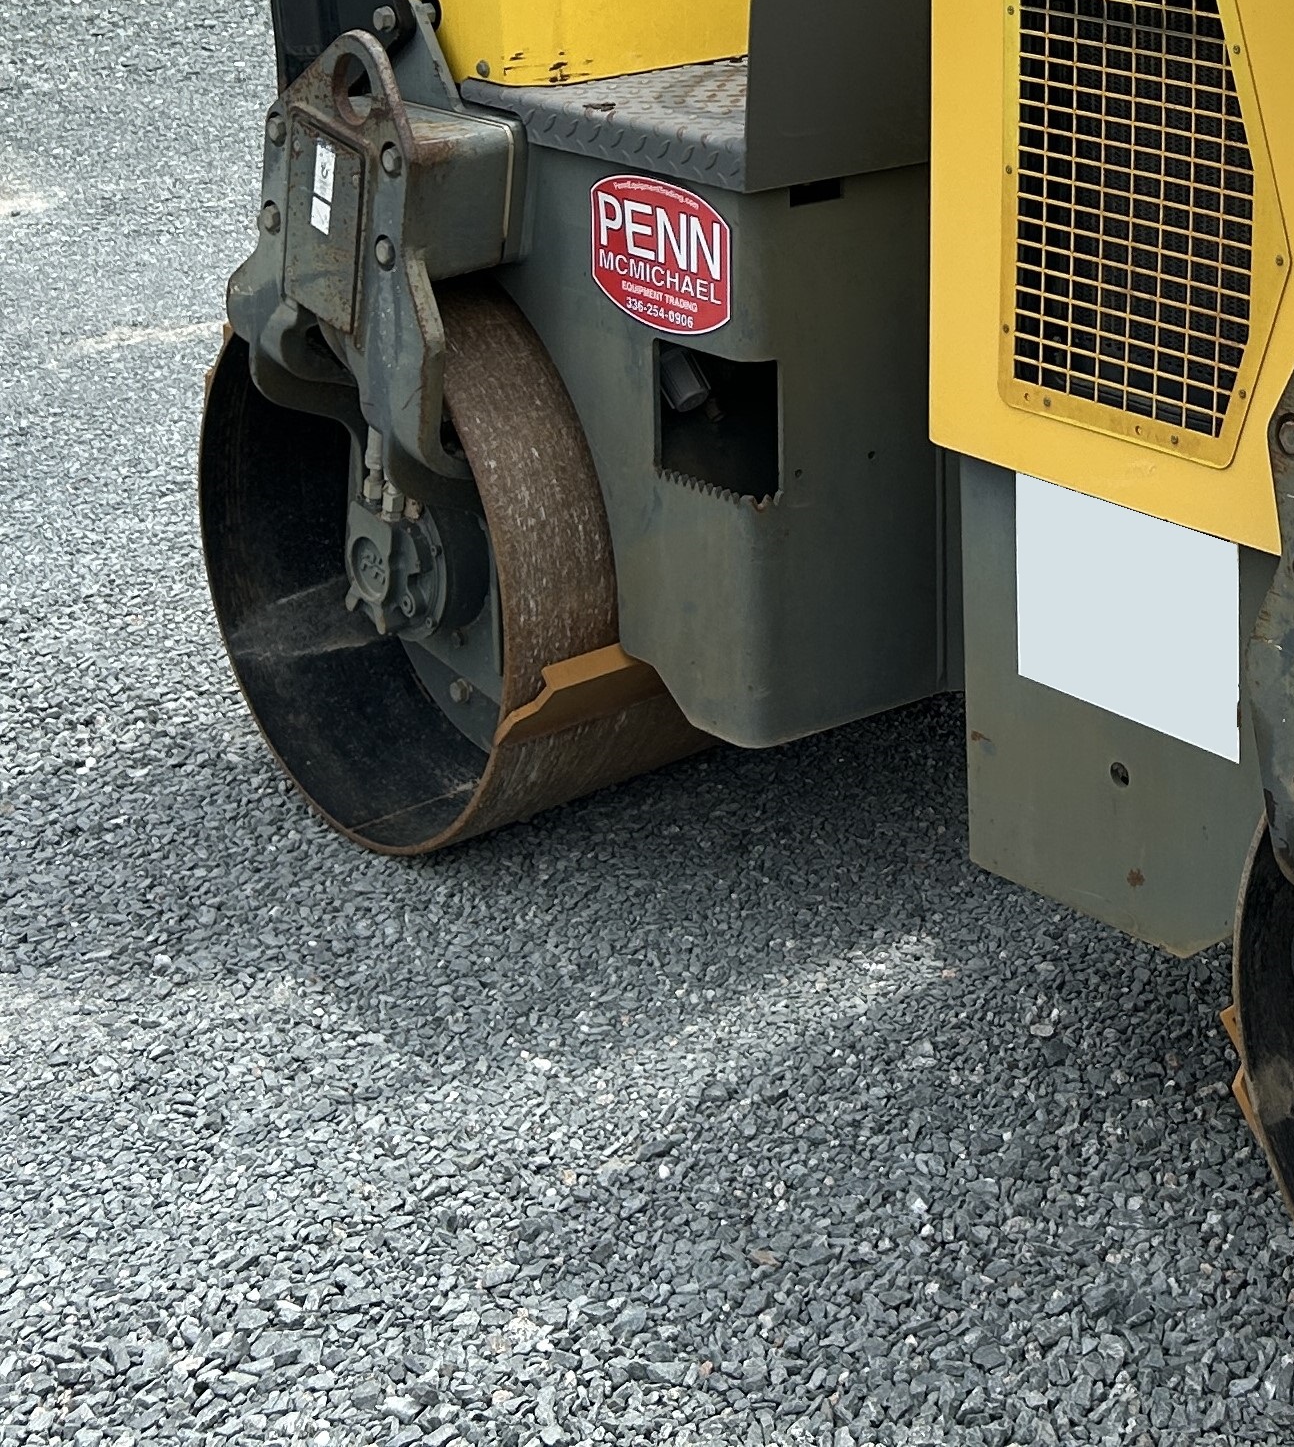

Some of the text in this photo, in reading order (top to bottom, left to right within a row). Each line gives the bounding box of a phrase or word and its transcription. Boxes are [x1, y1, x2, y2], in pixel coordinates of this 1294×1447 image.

[597, 191, 721, 281] PENN
[599, 249, 721, 305] MCMICHAEL
[621, 280, 698, 312] EQUIPMENT TRADING
[626, 296, 694, 329] 336-254-0906
